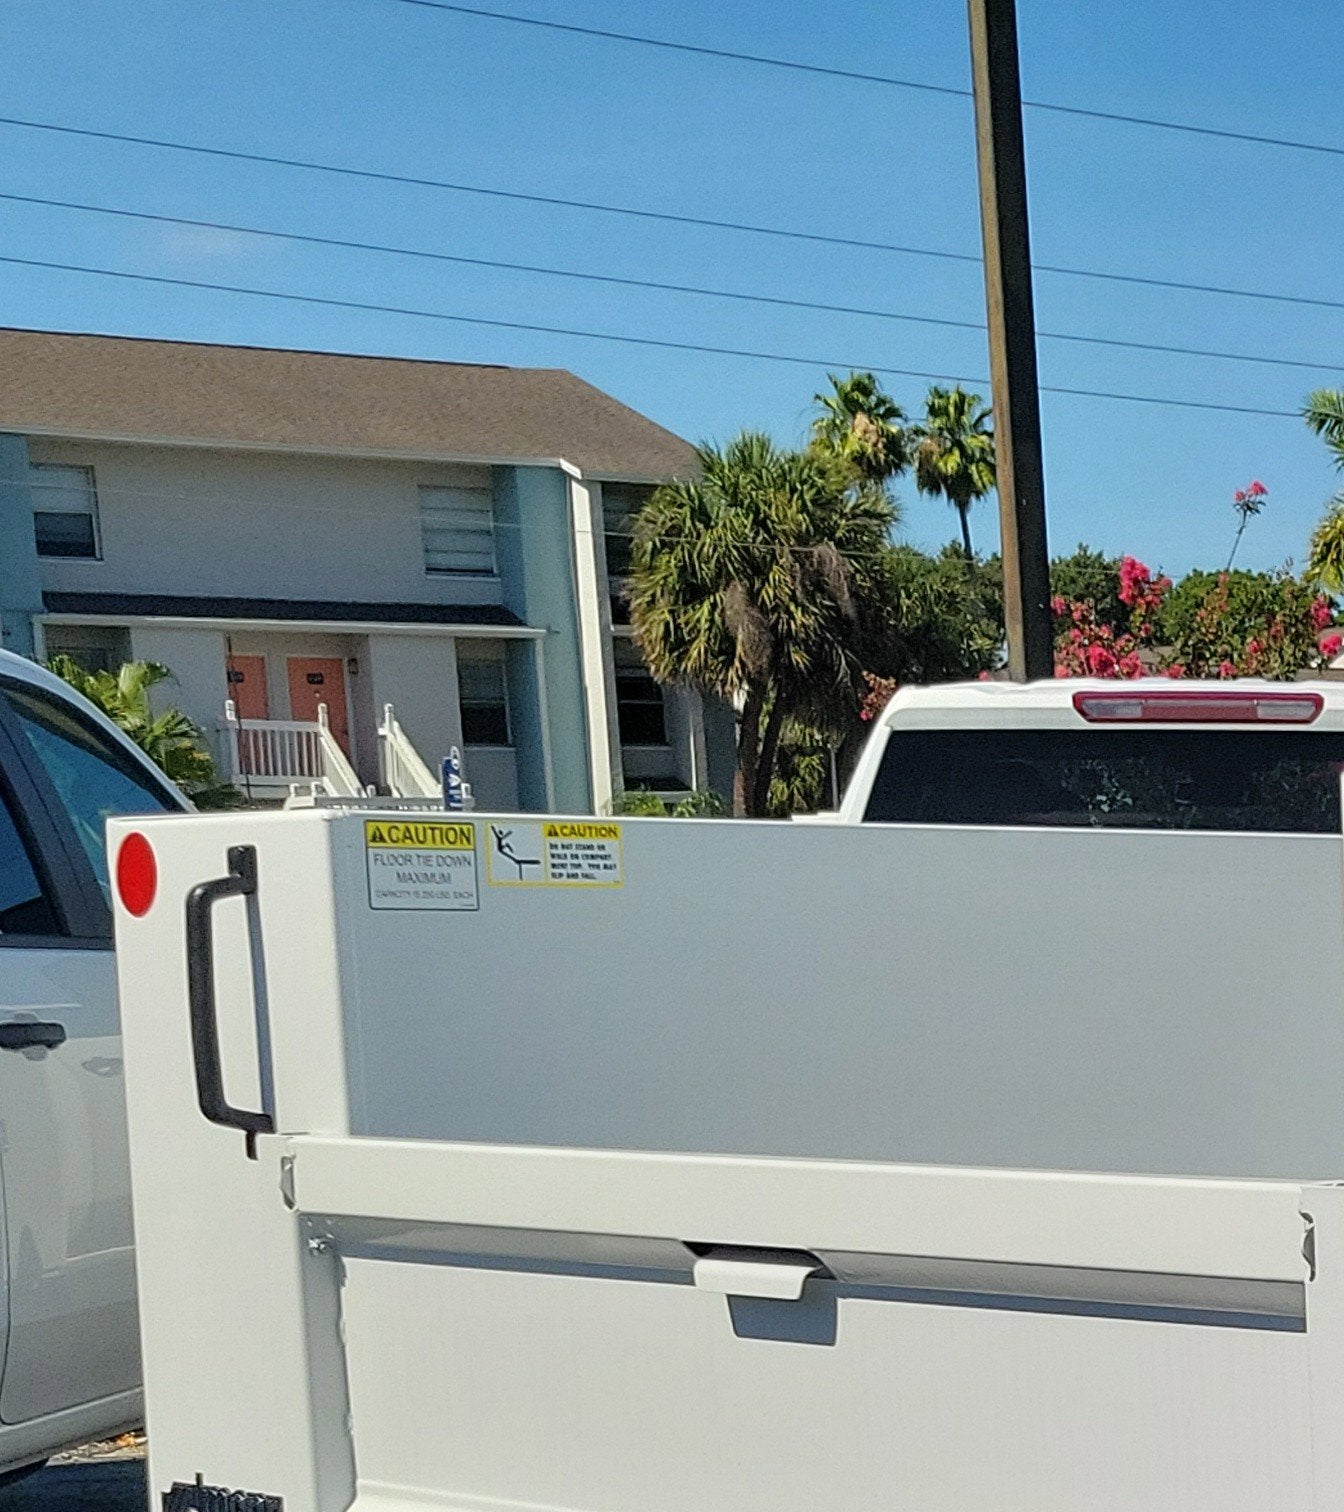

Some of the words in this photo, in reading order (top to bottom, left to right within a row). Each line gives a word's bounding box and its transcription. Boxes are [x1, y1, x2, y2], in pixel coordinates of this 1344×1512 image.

[387, 825, 472, 846] CAUTION
[560, 825, 618, 838] CAUTION
[373, 853, 414, 867] FLOOR
[416, 854, 434, 867] TIE
[436, 855, 472, 868] DOWN
